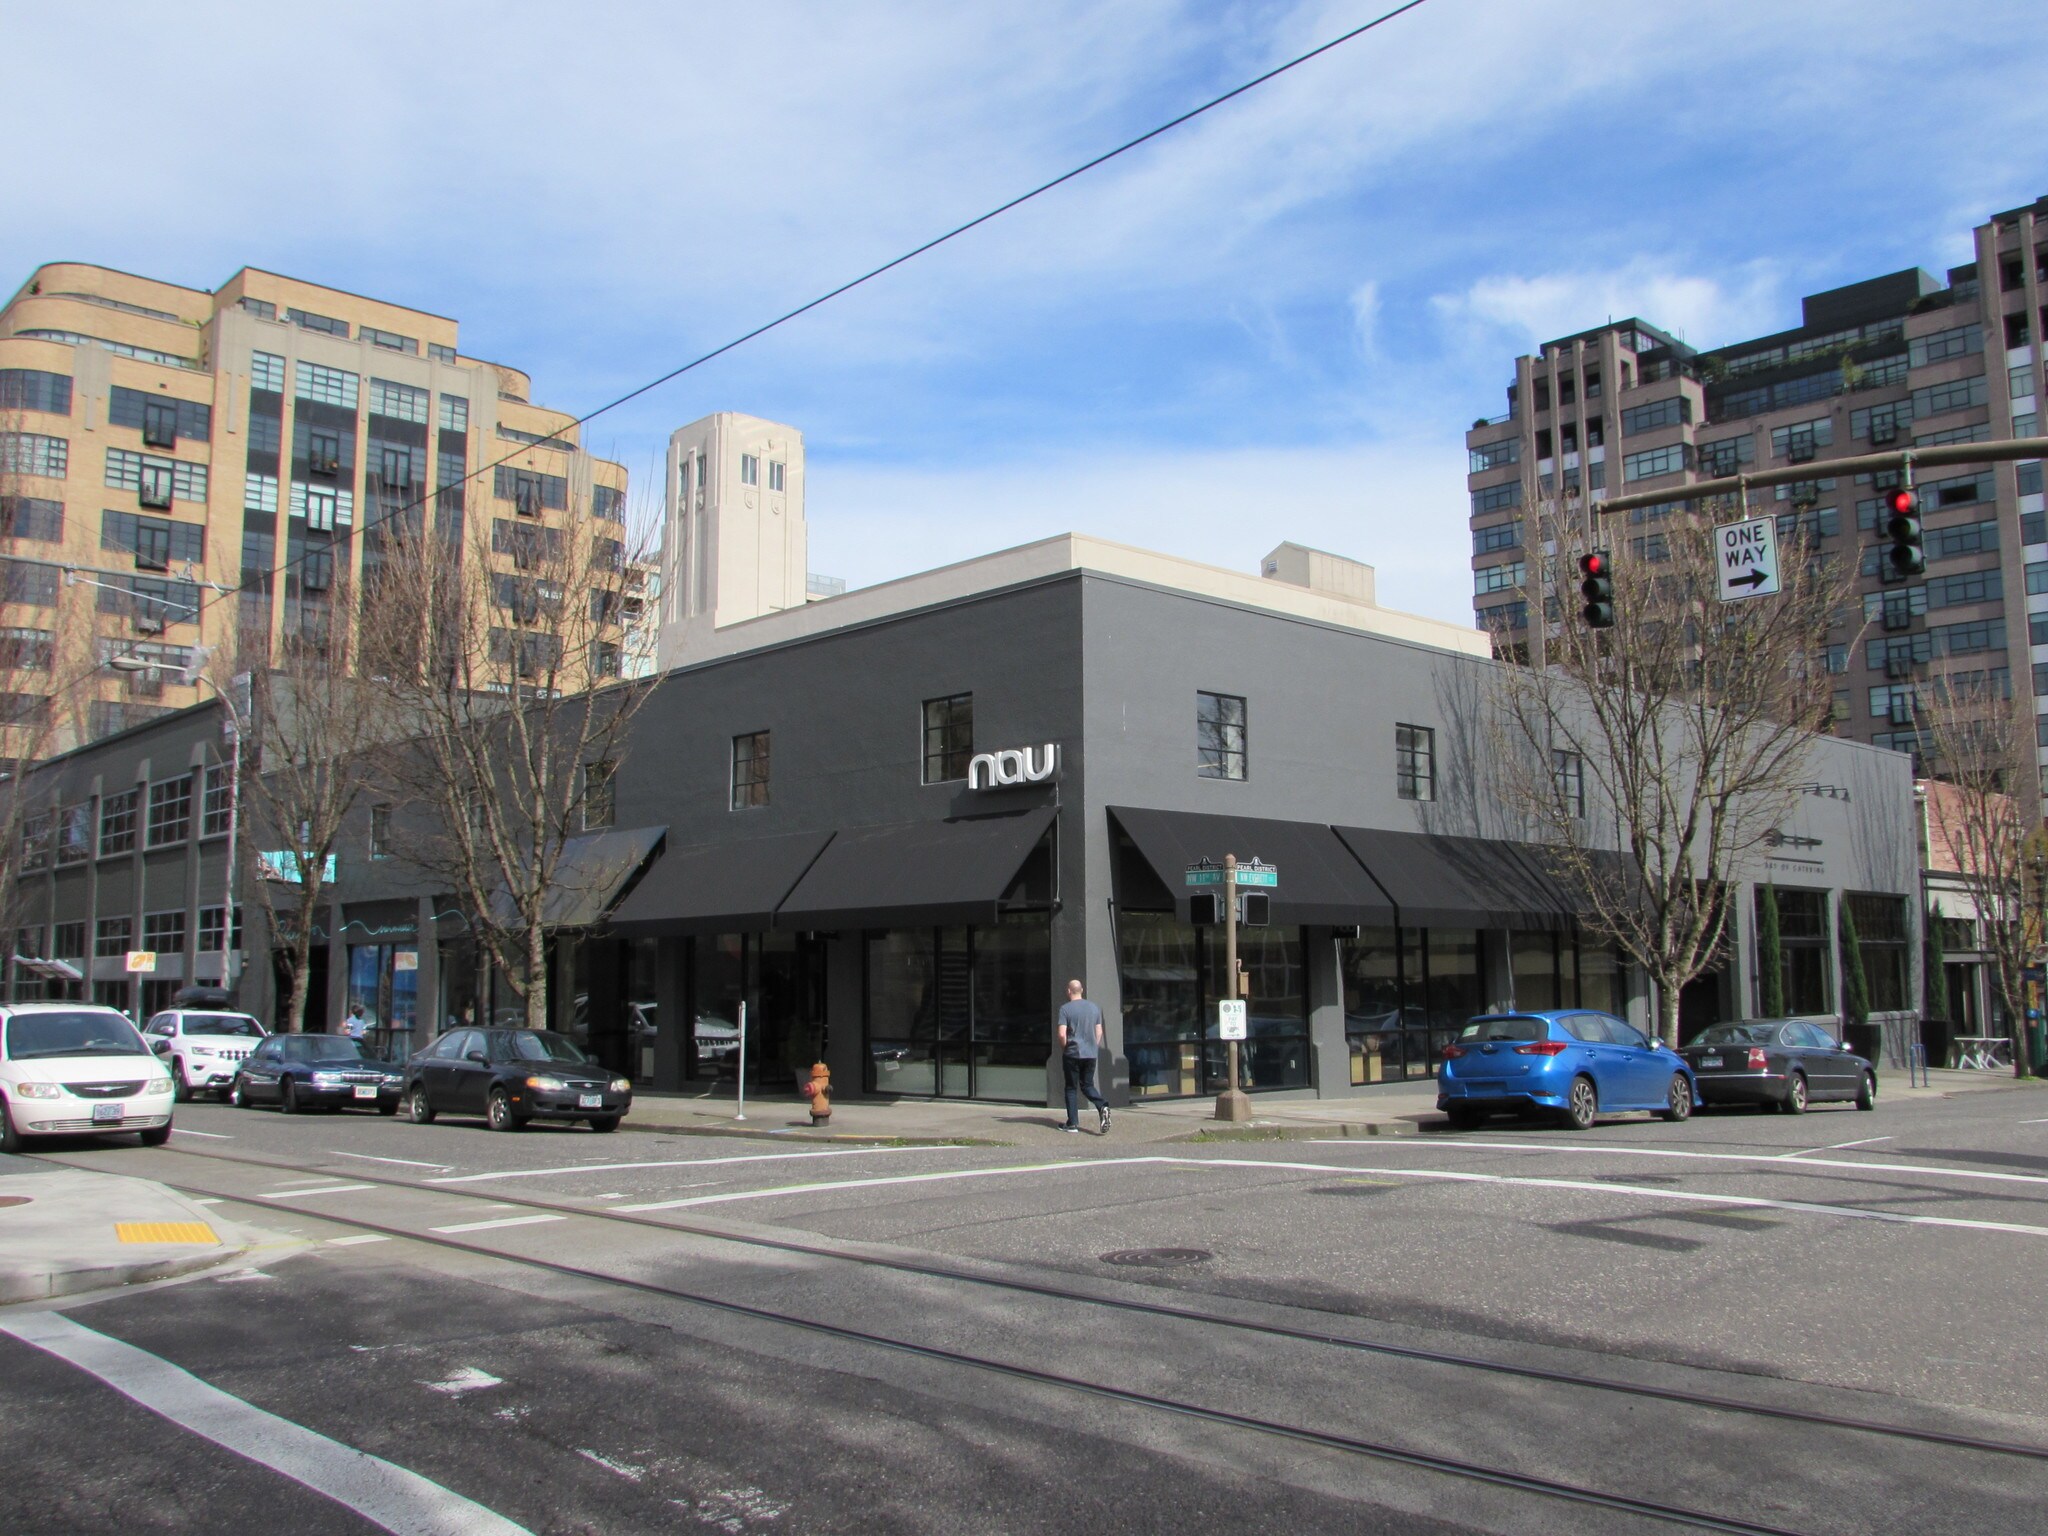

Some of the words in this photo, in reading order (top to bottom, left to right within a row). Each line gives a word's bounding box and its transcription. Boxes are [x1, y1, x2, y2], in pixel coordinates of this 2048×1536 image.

[1726, 525, 1764, 547] ONE
[1726, 544, 1766, 568] WAY
[968, 744, 1054, 790] nau
